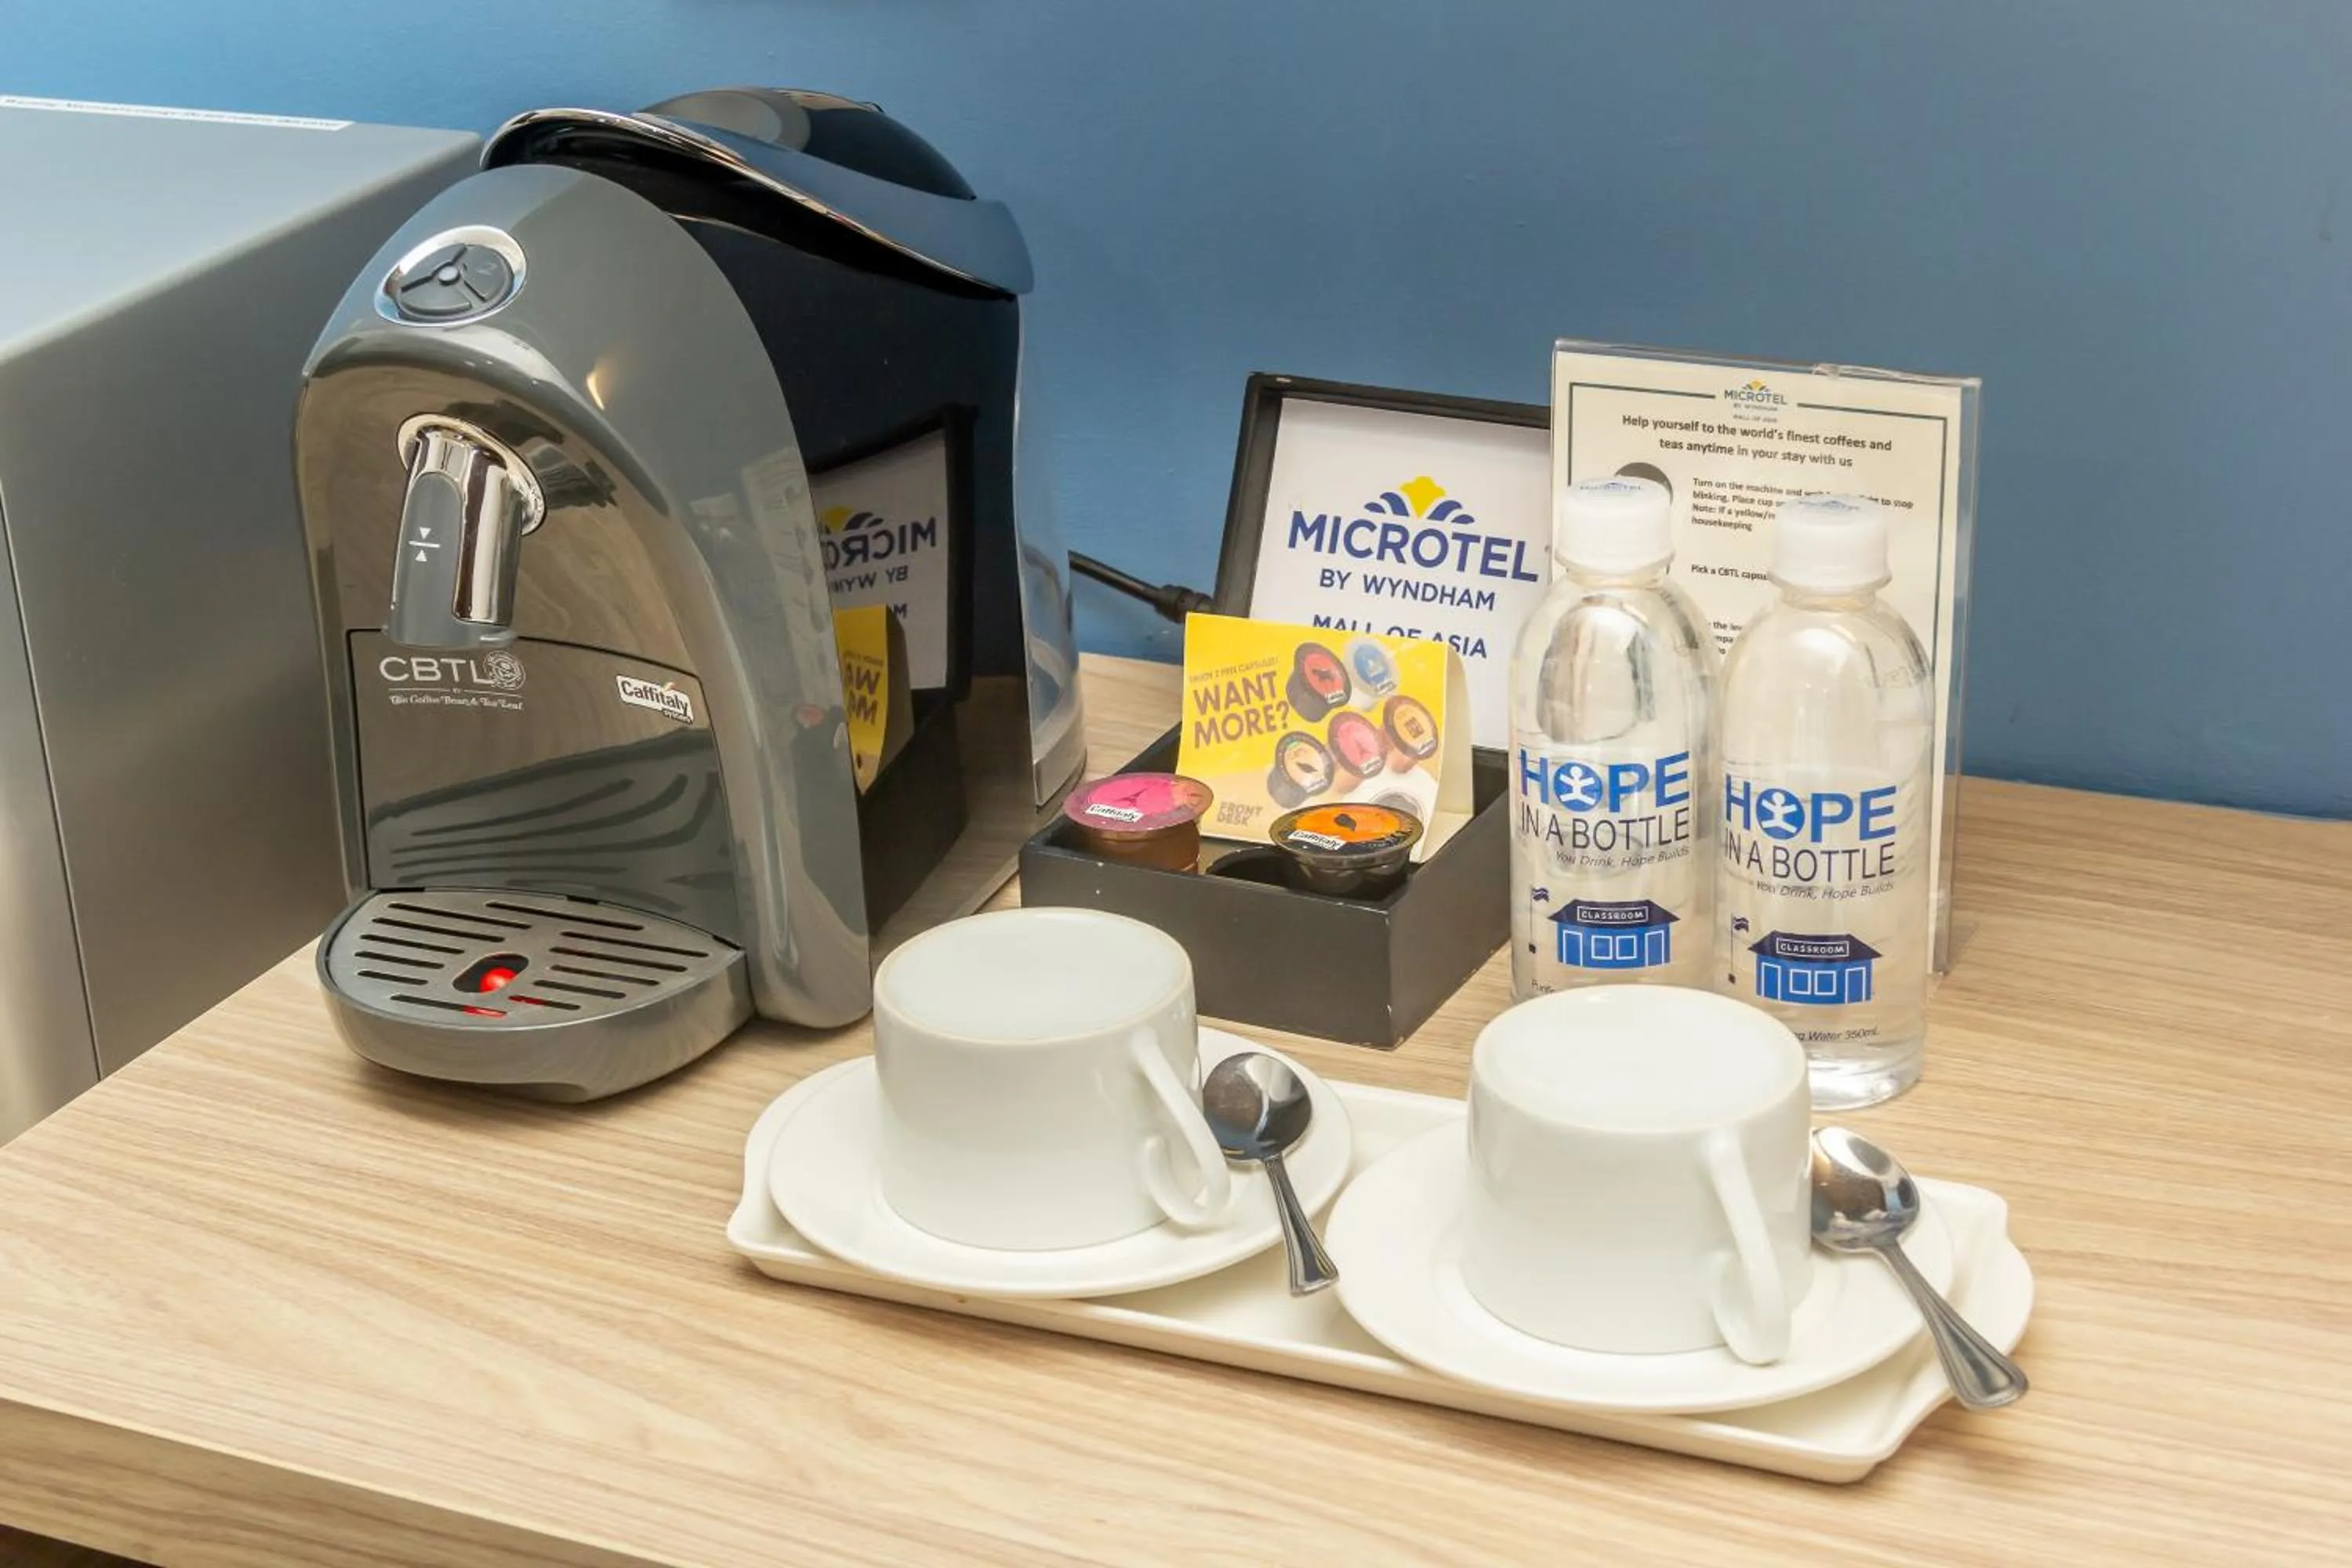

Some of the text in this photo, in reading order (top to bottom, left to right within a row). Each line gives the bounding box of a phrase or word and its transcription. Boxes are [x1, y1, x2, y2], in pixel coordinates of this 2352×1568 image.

[1724, 389, 1788, 405] MICROTEL
[1622, 415, 1892, 451] Help yourself to the world's finest coffees and
[1660, 438, 1853, 467] teas anytime in your stay with us
[1693, 477, 1713, 487] Turn
[1729, 481, 1744, 491] the
[1746, 484, 1784, 494] machine
[1786, 488, 1802, 496] and
[1732, 494, 1755, 504] Place
[1692, 516, 1753, 532] housekeeping
[1287, 510, 1539, 583] MICROTEL
[1691, 564, 1708, 574] Pick
[1319, 568, 1496, 612] BY WYNDHAM
[379, 656, 495, 684] CBTL
[620, 680, 688, 717] Caffitaly
[1192, 670, 1277, 716] WANT
[1194, 700, 1290, 750] MORE?
[1519, 749, 1690, 813] HOPE
[1726, 773, 1896, 843] HOPE
[1521, 801, 1690, 851] IN A BOTTLE
[1556, 851, 1575, 865] You
[1621, 853, 1656, 867] Hope
[1725, 827, 1896, 883] IN A BOTTLE
[1757, 880, 1776, 894] You
[1821, 887, 1857, 901] Hope
[1581, 910, 1644, 920] CLASSROOM
[1780, 942, 1845, 954] CLASSROOM
[1809, 1031, 1842, 1041] Water
